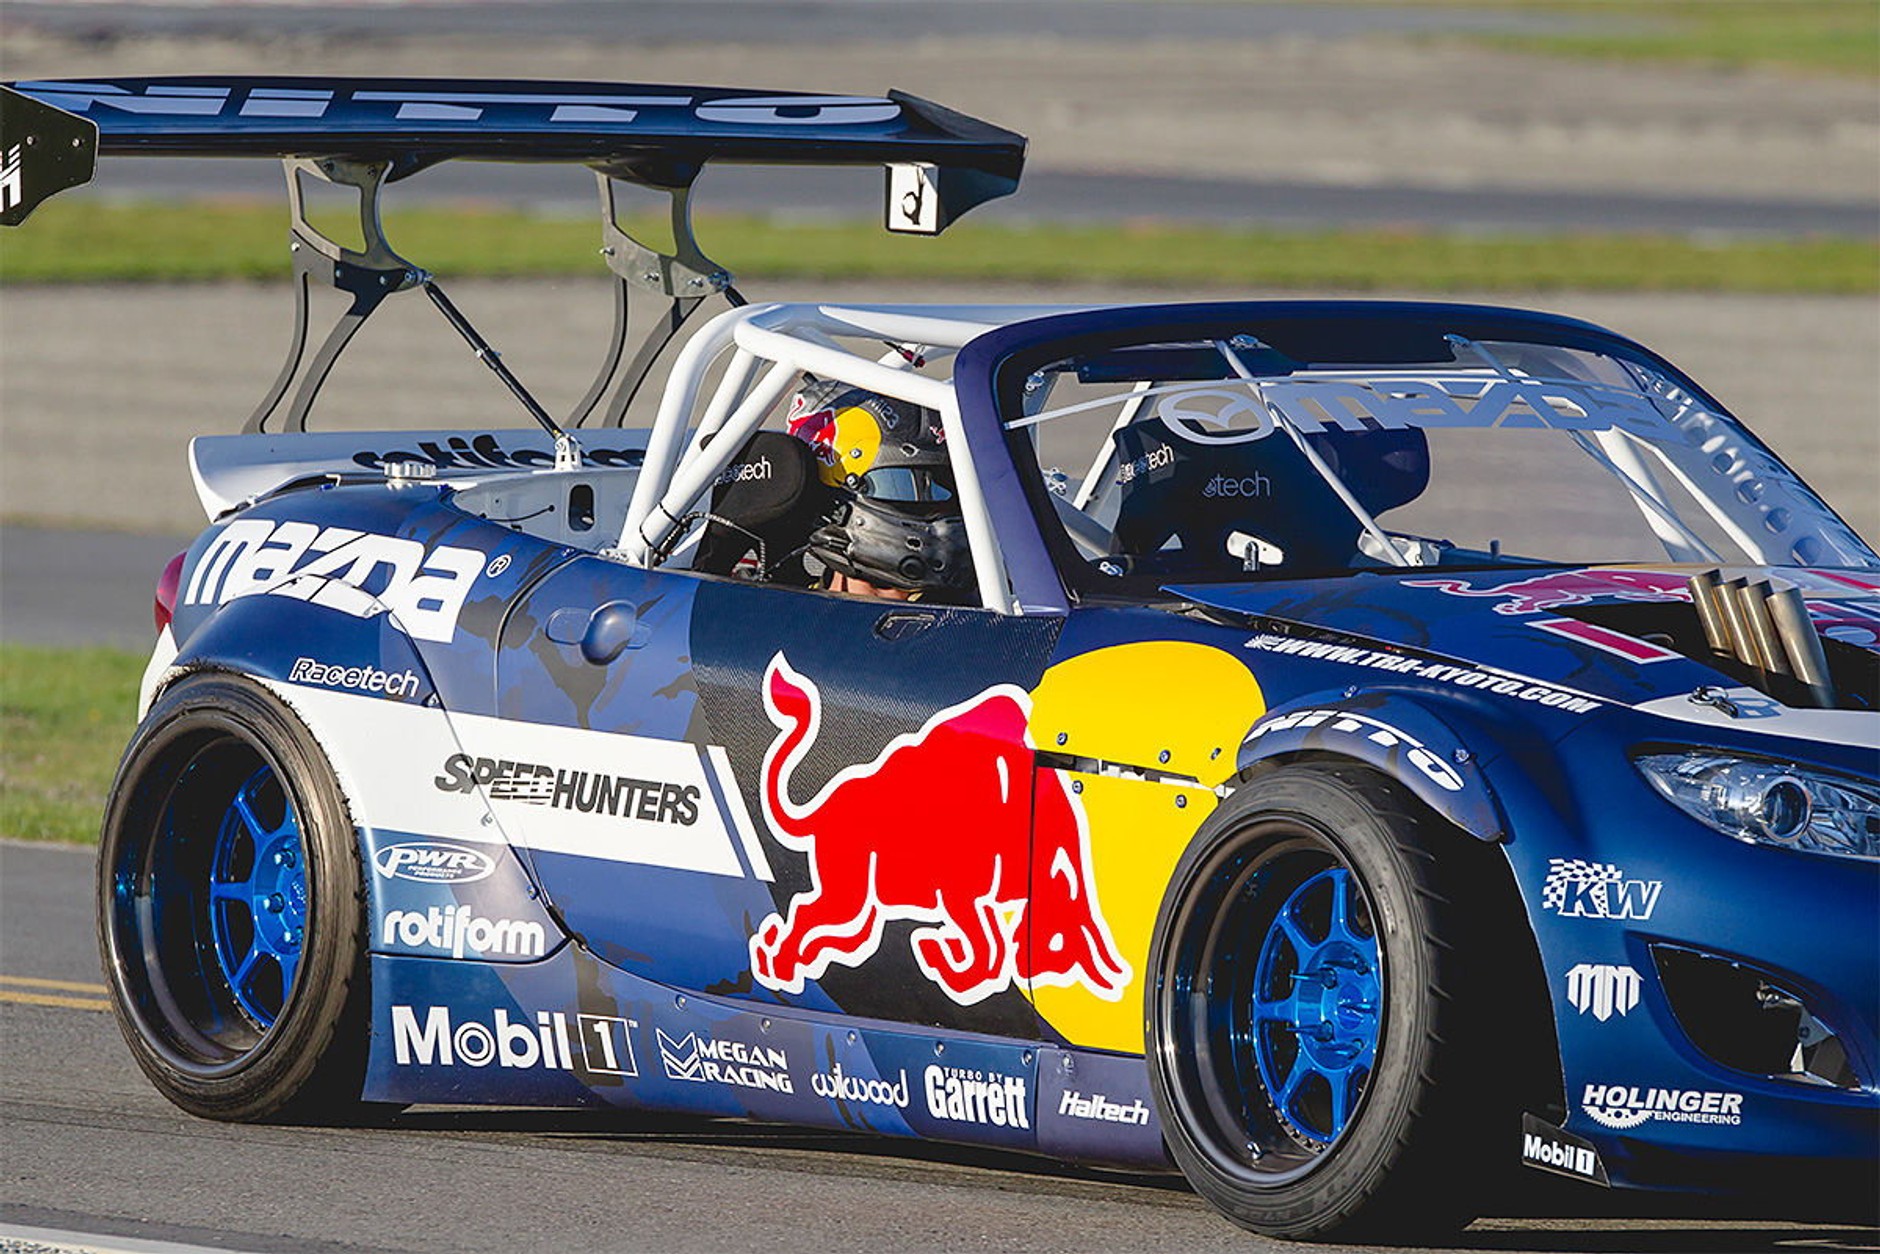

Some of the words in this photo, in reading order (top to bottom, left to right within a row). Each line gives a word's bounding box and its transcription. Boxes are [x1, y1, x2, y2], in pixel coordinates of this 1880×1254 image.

[13, 79, 902, 125] NITTO
[289, 657, 420, 698] Racetech
[1273, 637, 1602, 714] WWW.TRA-KYOTO.COM
[1243, 709, 1465, 791] NITTO
[434, 753, 701, 827] SPEEDHUNTERS
[385, 848, 484, 878] PWR
[1558, 880, 1663, 919] KW
[383, 905, 545, 959] rotiform
[391, 1005, 575, 1071] Mobil
[698, 1038, 788, 1070] MEGAN
[703, 1064, 793, 1094] RACING
[811, 1062, 910, 1108] wilwood
[944, 1068, 983, 1081] TURBO
[988, 1073, 1003, 1083] BY
[924, 1064, 1031, 1130] Garrett
[1058, 1090, 1150, 1126] Haltech
[1582, 1085, 1744, 1115] HOLINGER
[1653, 1110, 1742, 1126] ENGINEERING
[1523, 1133, 1574, 1170] Mobil
[1575, 1149, 1596, 1176] 1
